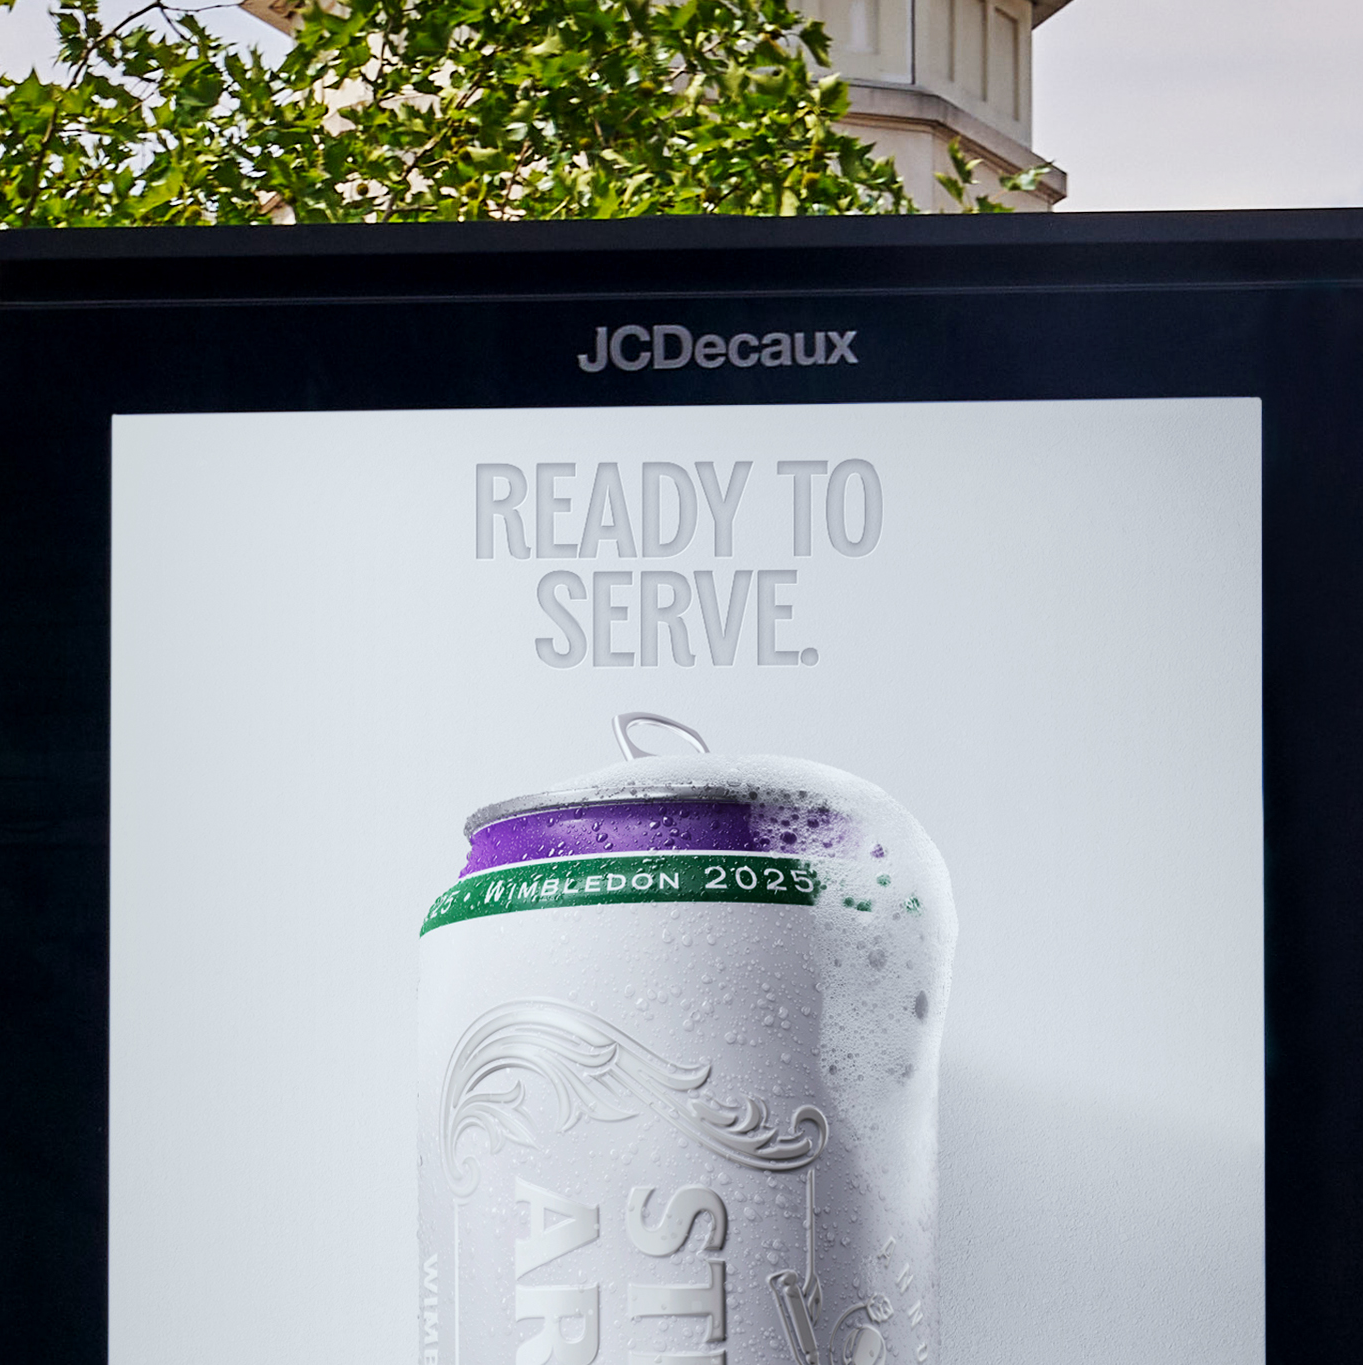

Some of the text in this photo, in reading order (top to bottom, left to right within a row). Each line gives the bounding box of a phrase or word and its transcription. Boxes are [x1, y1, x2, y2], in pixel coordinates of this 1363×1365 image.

[578, 325, 858, 372] JCDecaux
[475, 458, 884, 560] READY TO
[535, 569, 820, 669] SERVE.
[484, 872, 680, 905] WIMBLEDON
[704, 865, 815, 894] 2025
